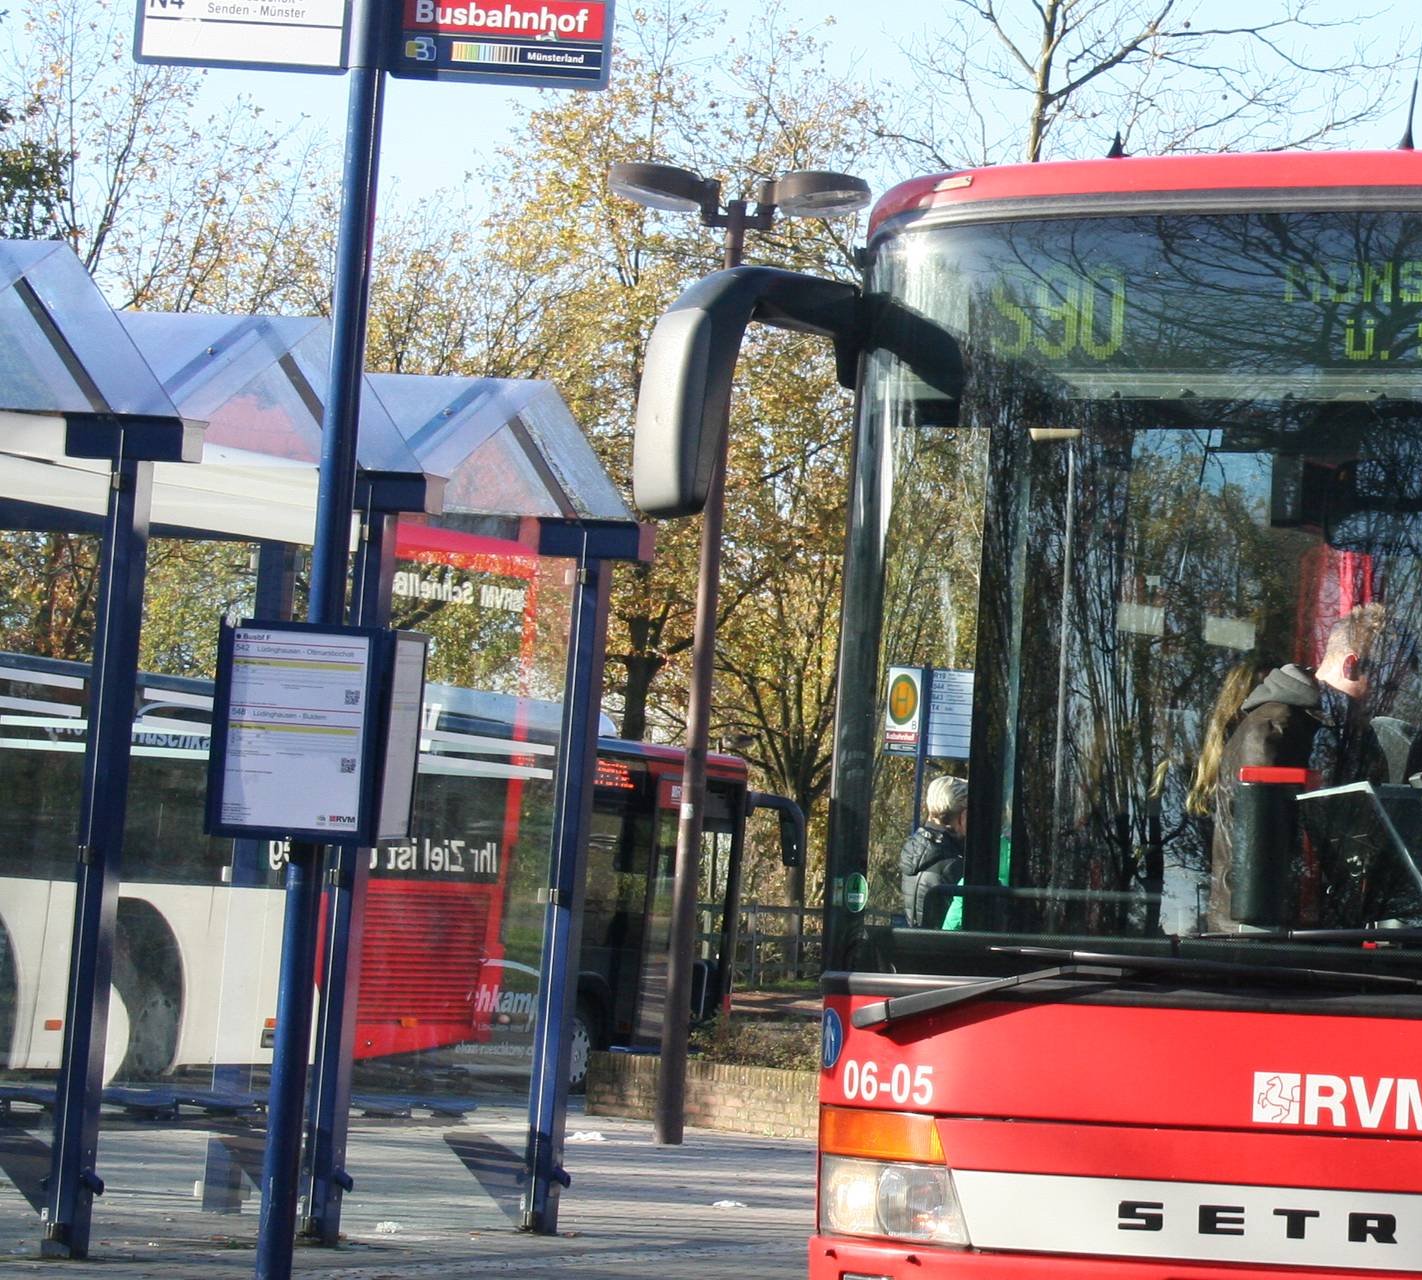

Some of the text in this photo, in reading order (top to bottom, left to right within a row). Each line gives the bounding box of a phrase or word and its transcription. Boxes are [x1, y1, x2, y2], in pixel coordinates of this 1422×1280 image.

[207, 3, 249, 15] Senden
[260, 5, 306, 18] Münster
[416, 0, 588, 33] Busbahnhof
[527, 51, 584, 63] Münsterland
[336, 815, 356, 824] RVM
[843, 1060, 933, 1105] 06-05
